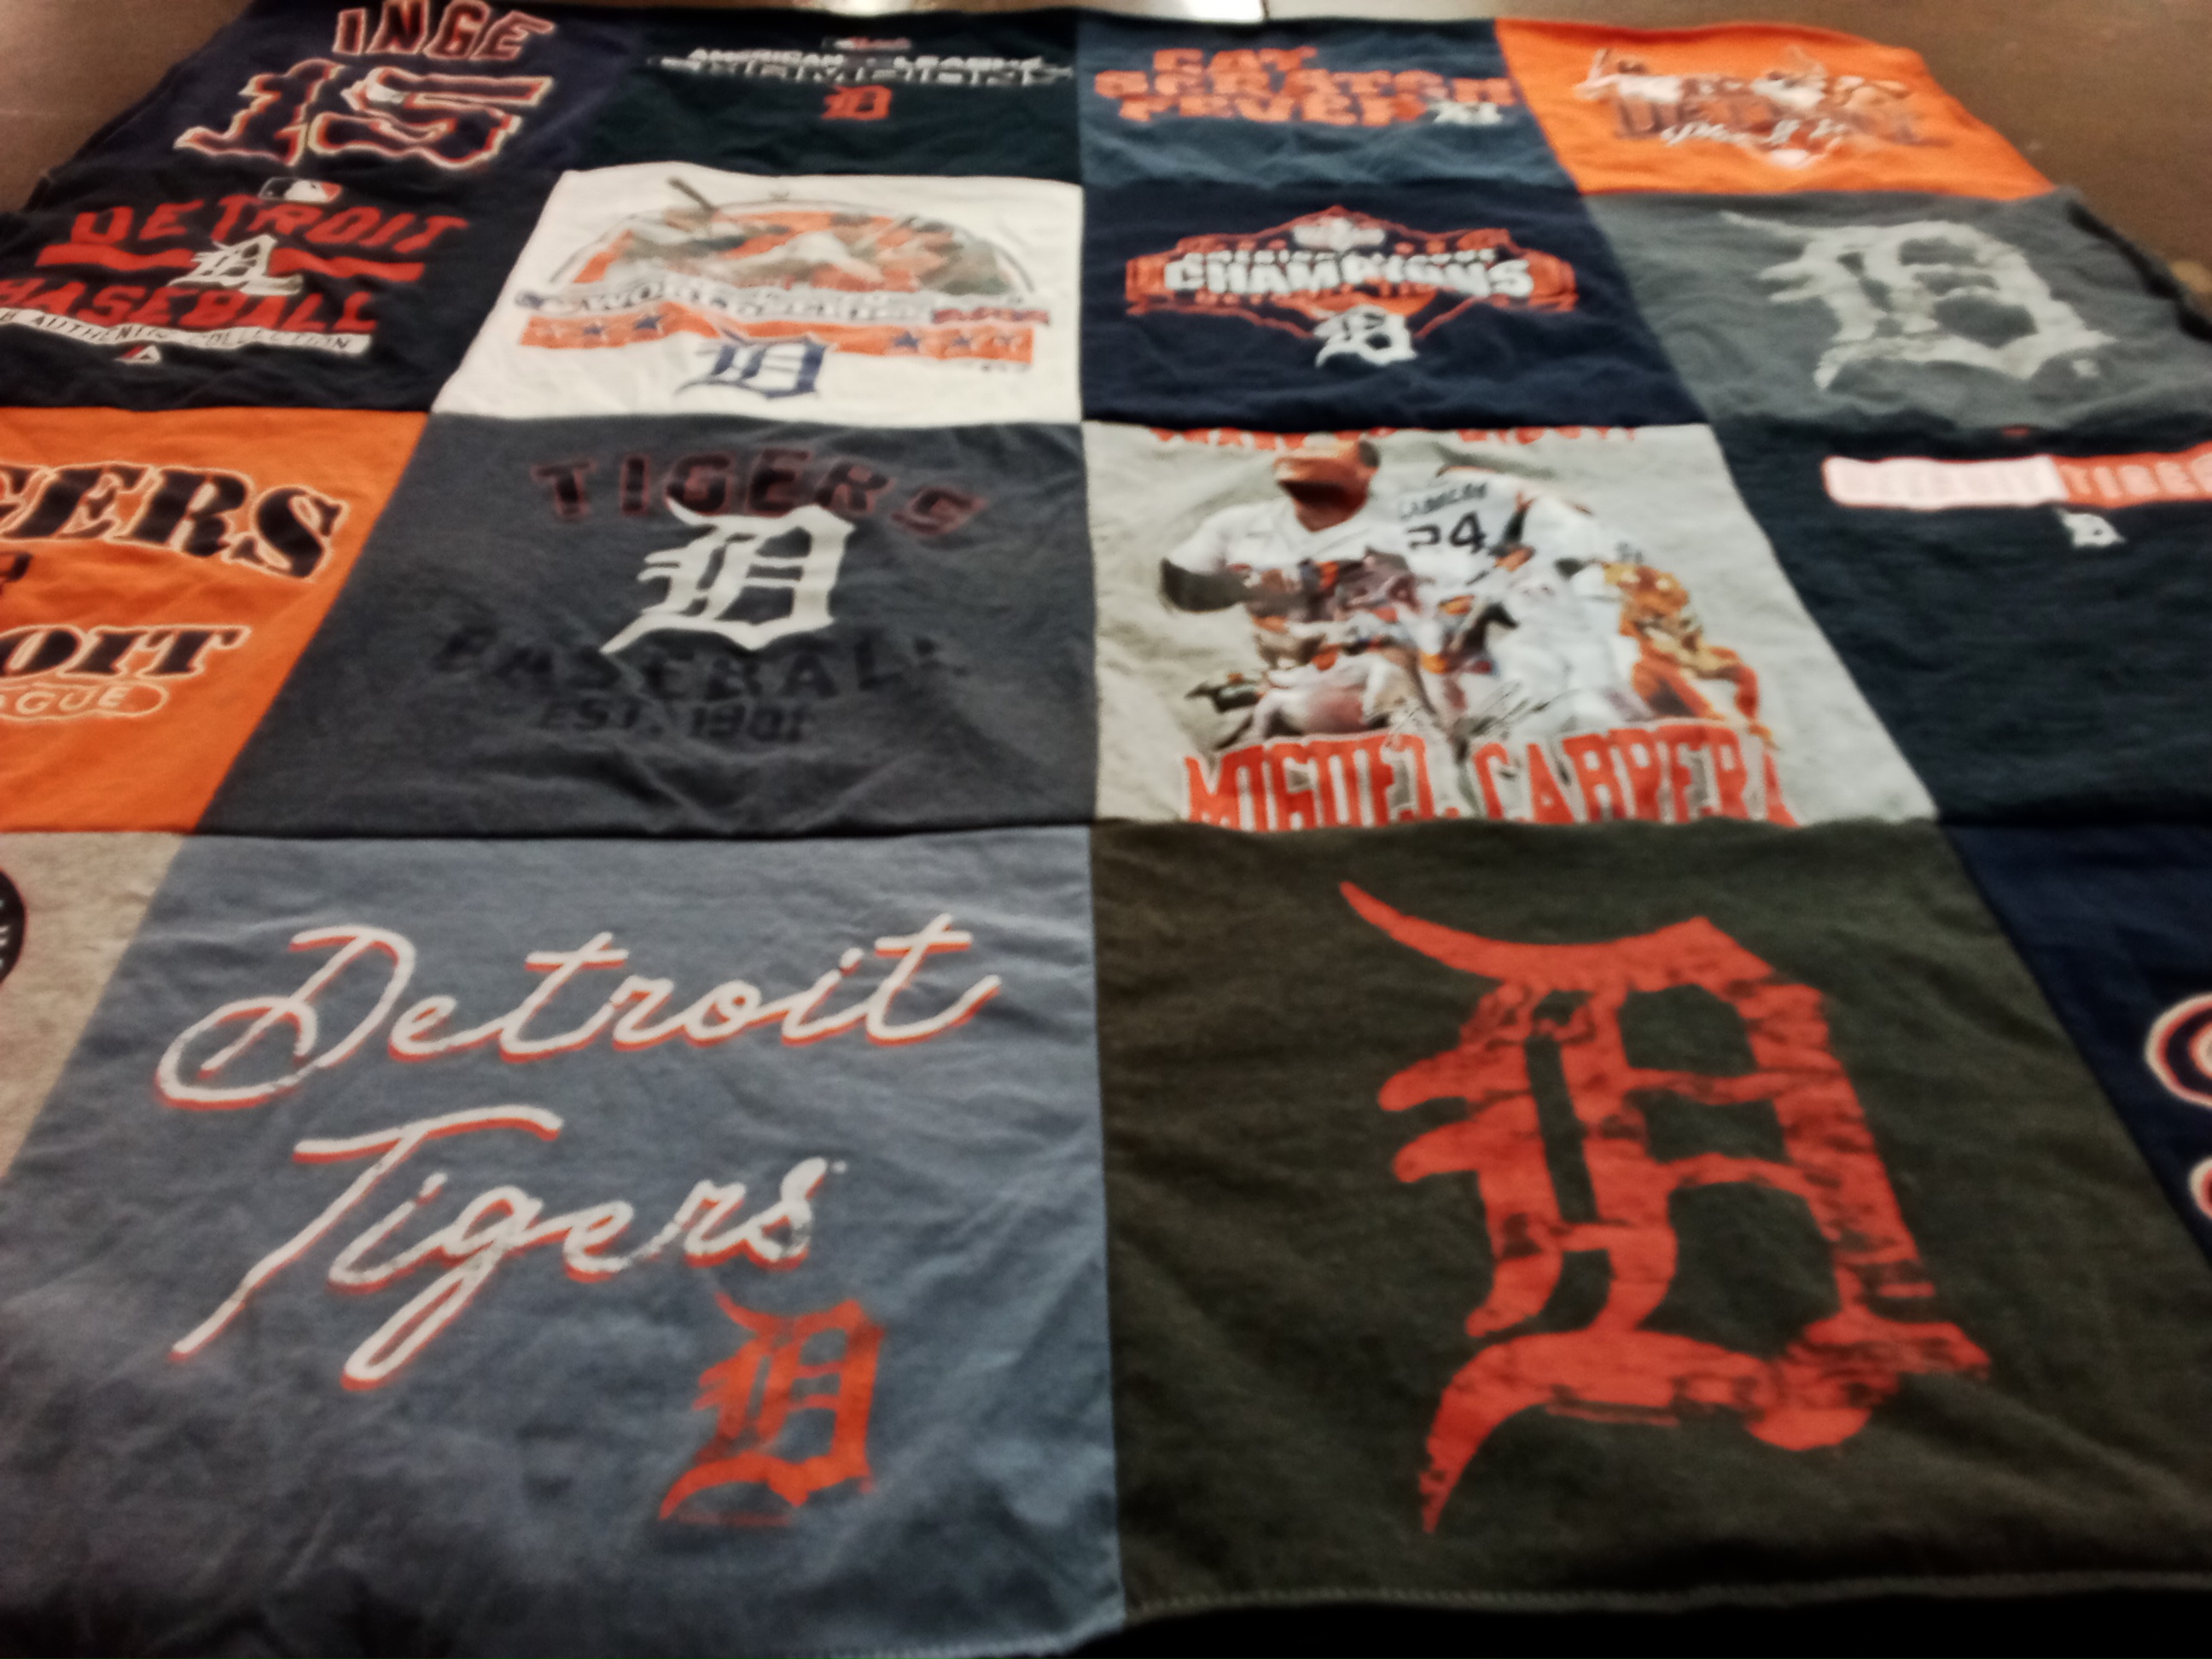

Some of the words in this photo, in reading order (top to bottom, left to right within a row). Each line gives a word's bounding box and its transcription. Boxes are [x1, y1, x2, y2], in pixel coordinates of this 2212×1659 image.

[332, 0, 556, 61] INGE
[173, 58, 555, 169] 15
[71, 194, 468, 253] DETROIT
[1164, 252, 1534, 298] CHAMPIONS
[531, 449, 991, 538] TIGERS
[0, 685, 131, 715] GUE
[155, 913, 1001, 1109] Detroit
[172, 1103, 830, 1391] Tigers
